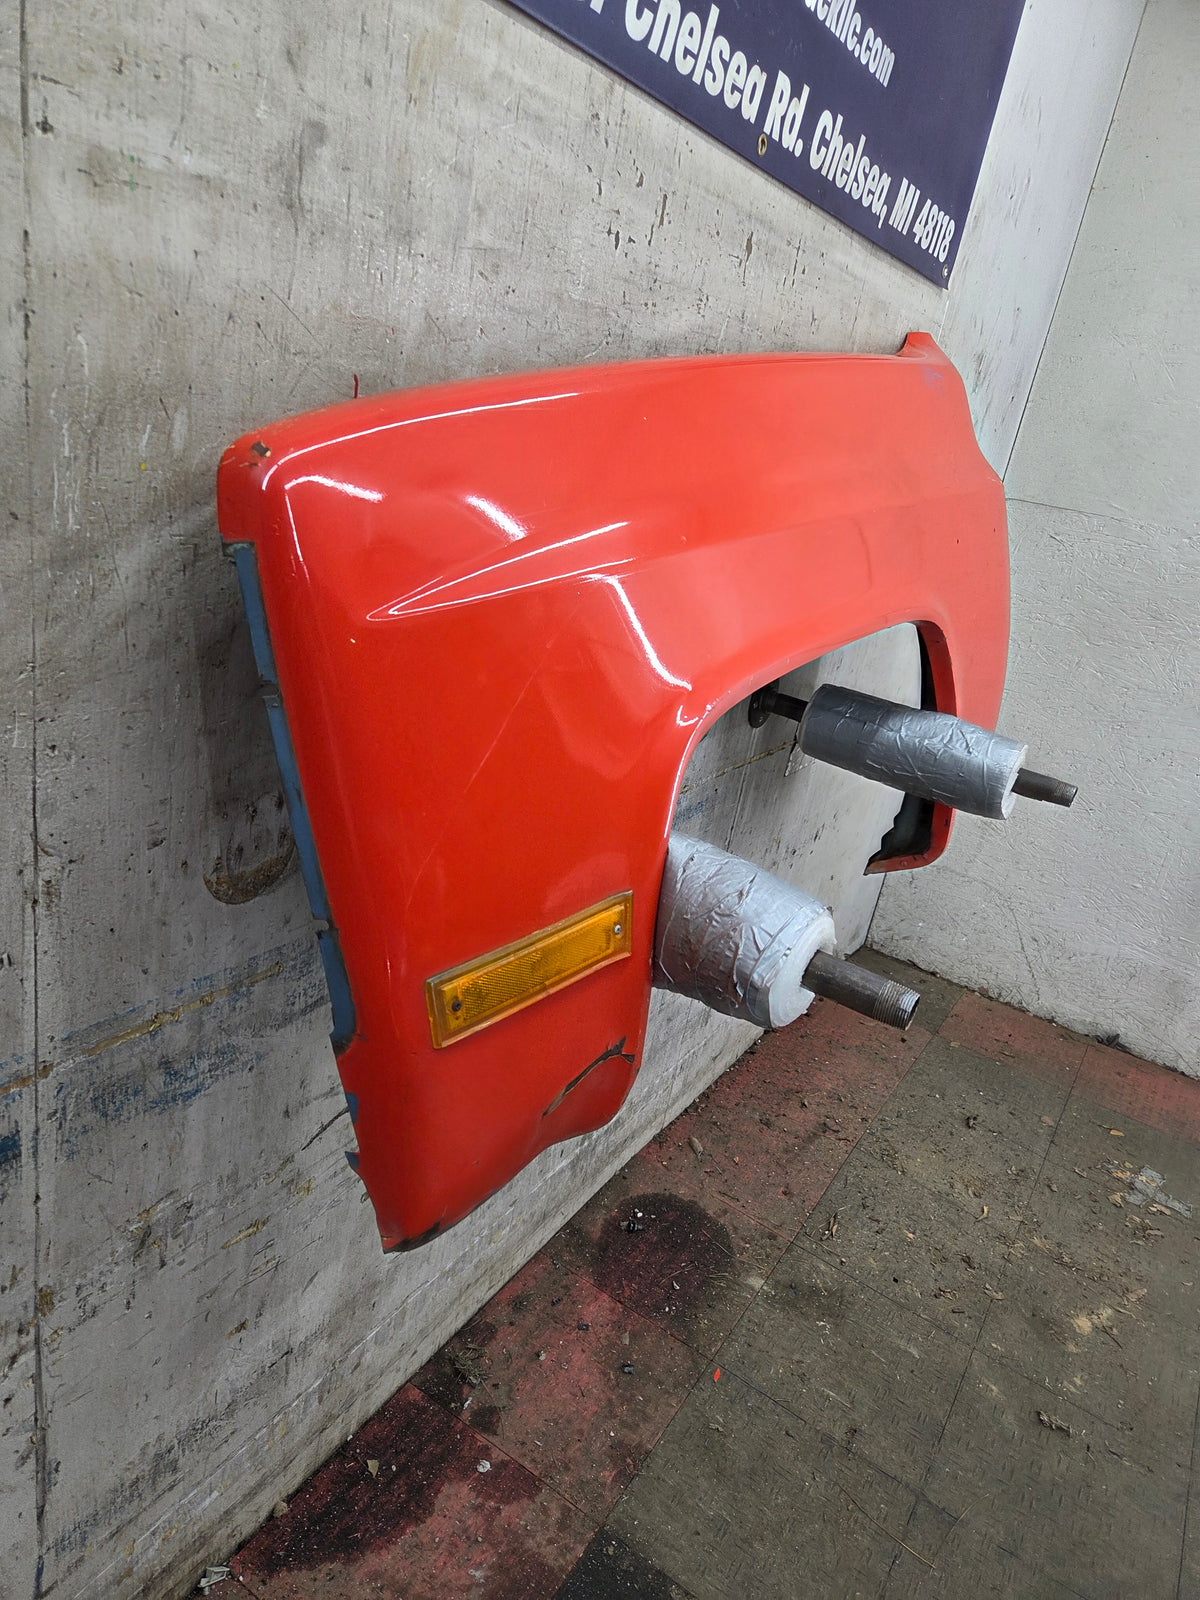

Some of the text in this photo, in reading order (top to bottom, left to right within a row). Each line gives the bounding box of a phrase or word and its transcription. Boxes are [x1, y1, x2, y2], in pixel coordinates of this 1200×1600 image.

[625, 0, 956, 263] Chelsea Rd. Chelsea, MI 48118
[805, 0, 895, 88] ckllc.com
